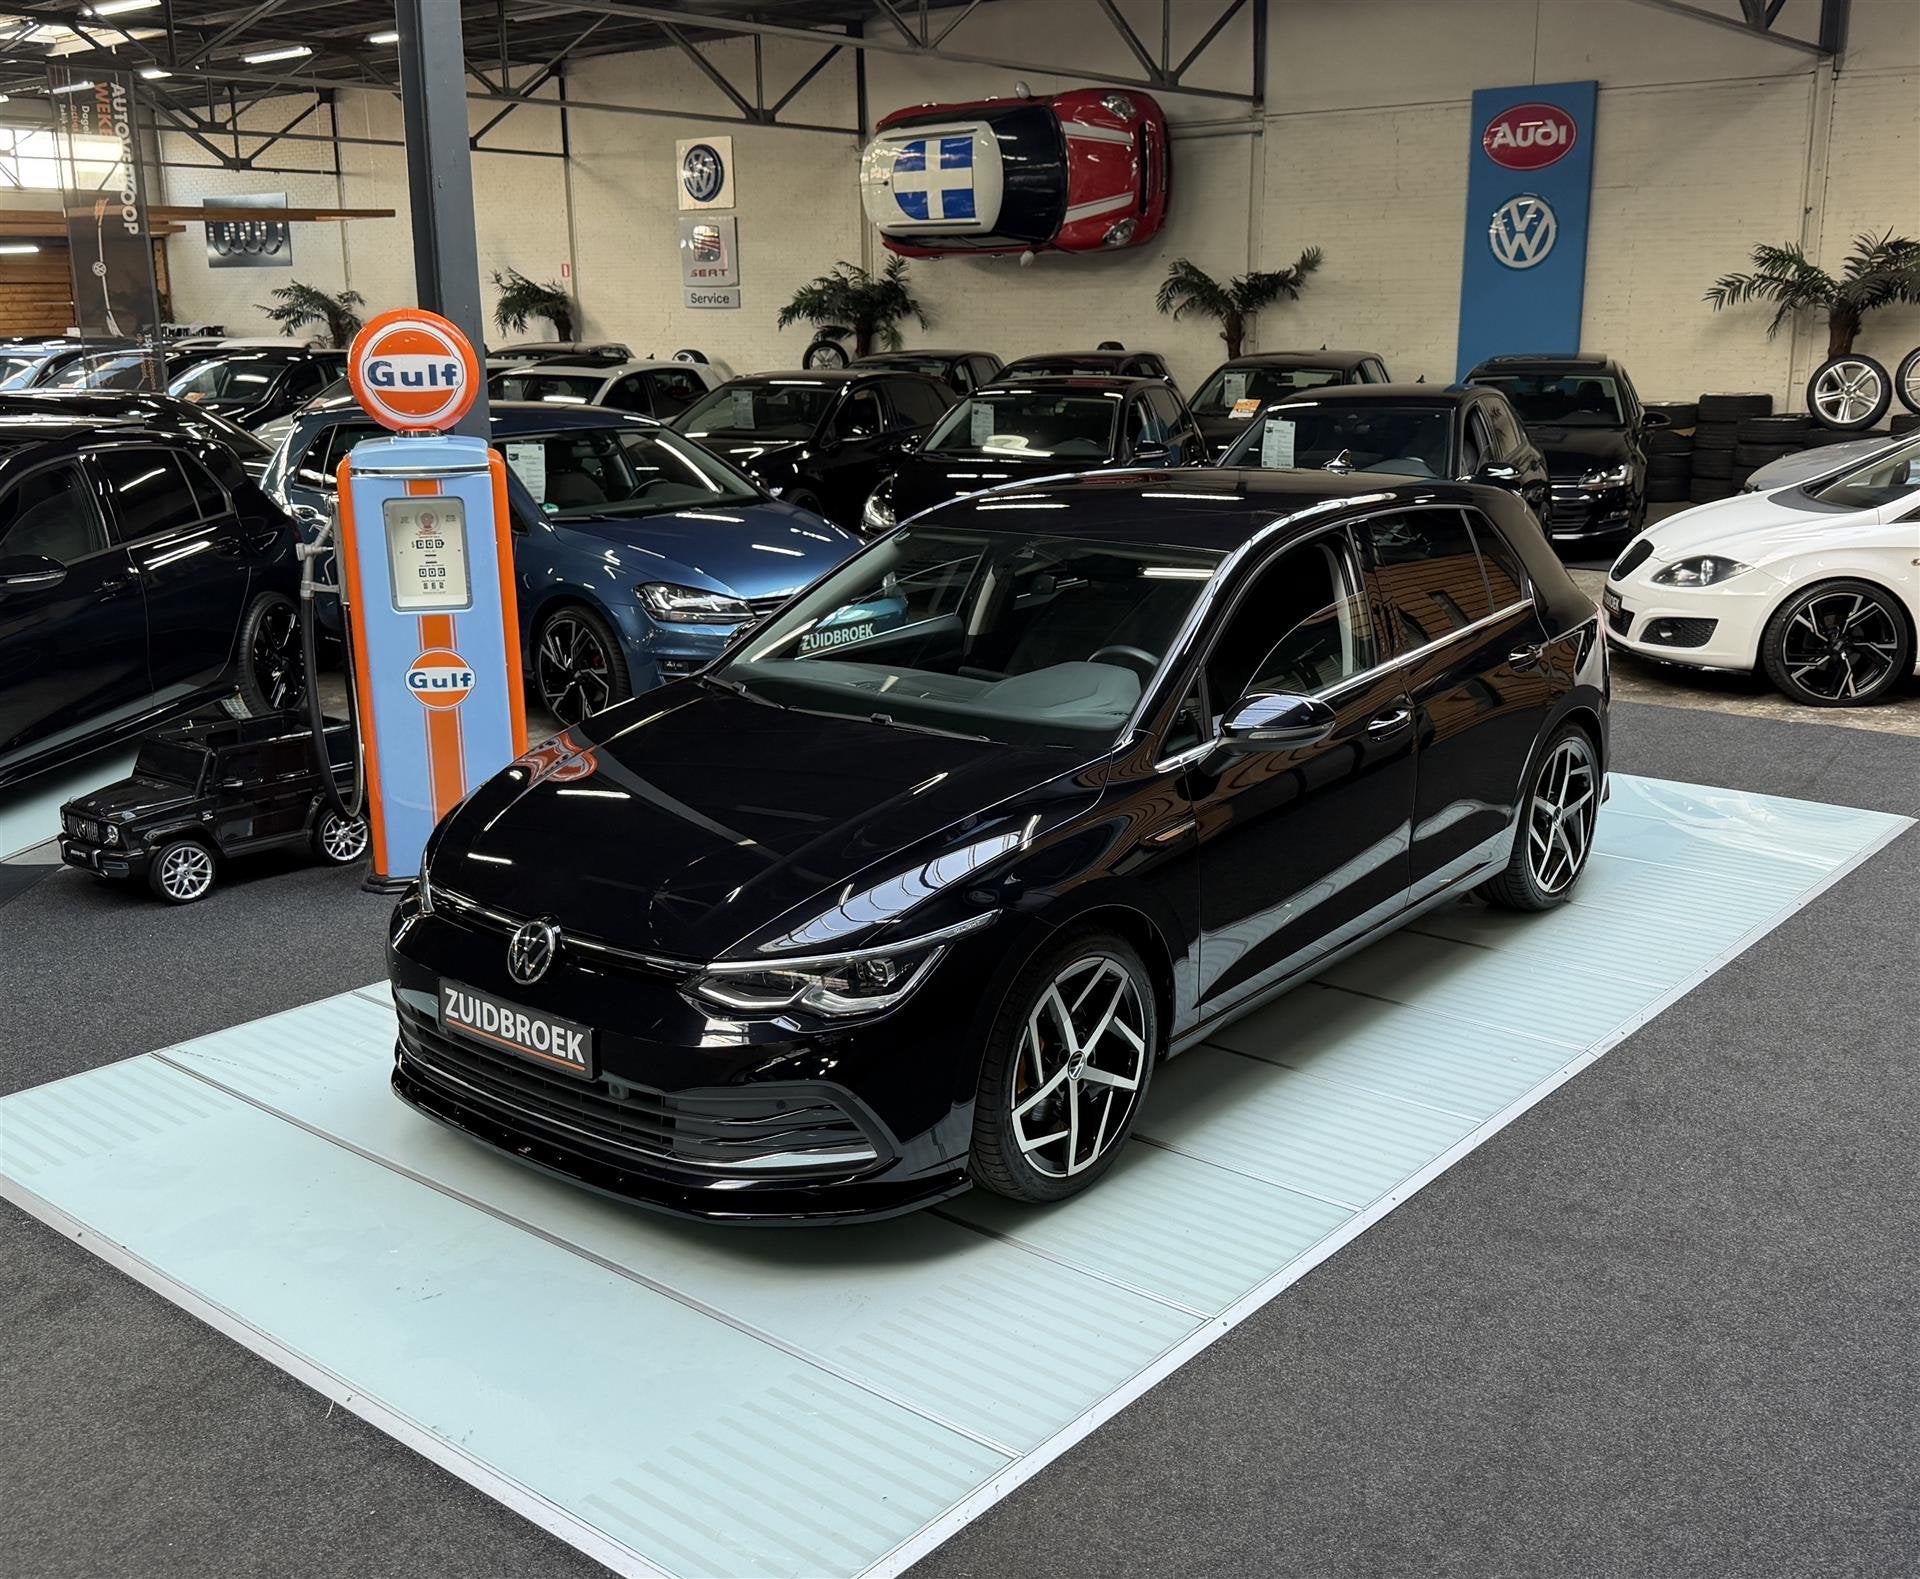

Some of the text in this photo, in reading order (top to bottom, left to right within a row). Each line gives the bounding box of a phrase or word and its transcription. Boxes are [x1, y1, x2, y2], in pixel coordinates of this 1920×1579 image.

[1491, 119, 1567, 148] Audi
[690, 268, 728, 277] SEAT
[690, 292, 730, 304] Service
[367, 360, 457, 386] Gulf
[801, 623, 873, 650] ZUIDBROEK
[408, 671, 472, 689] Gulf
[445, 987, 585, 1063] ZUIDBROEK
